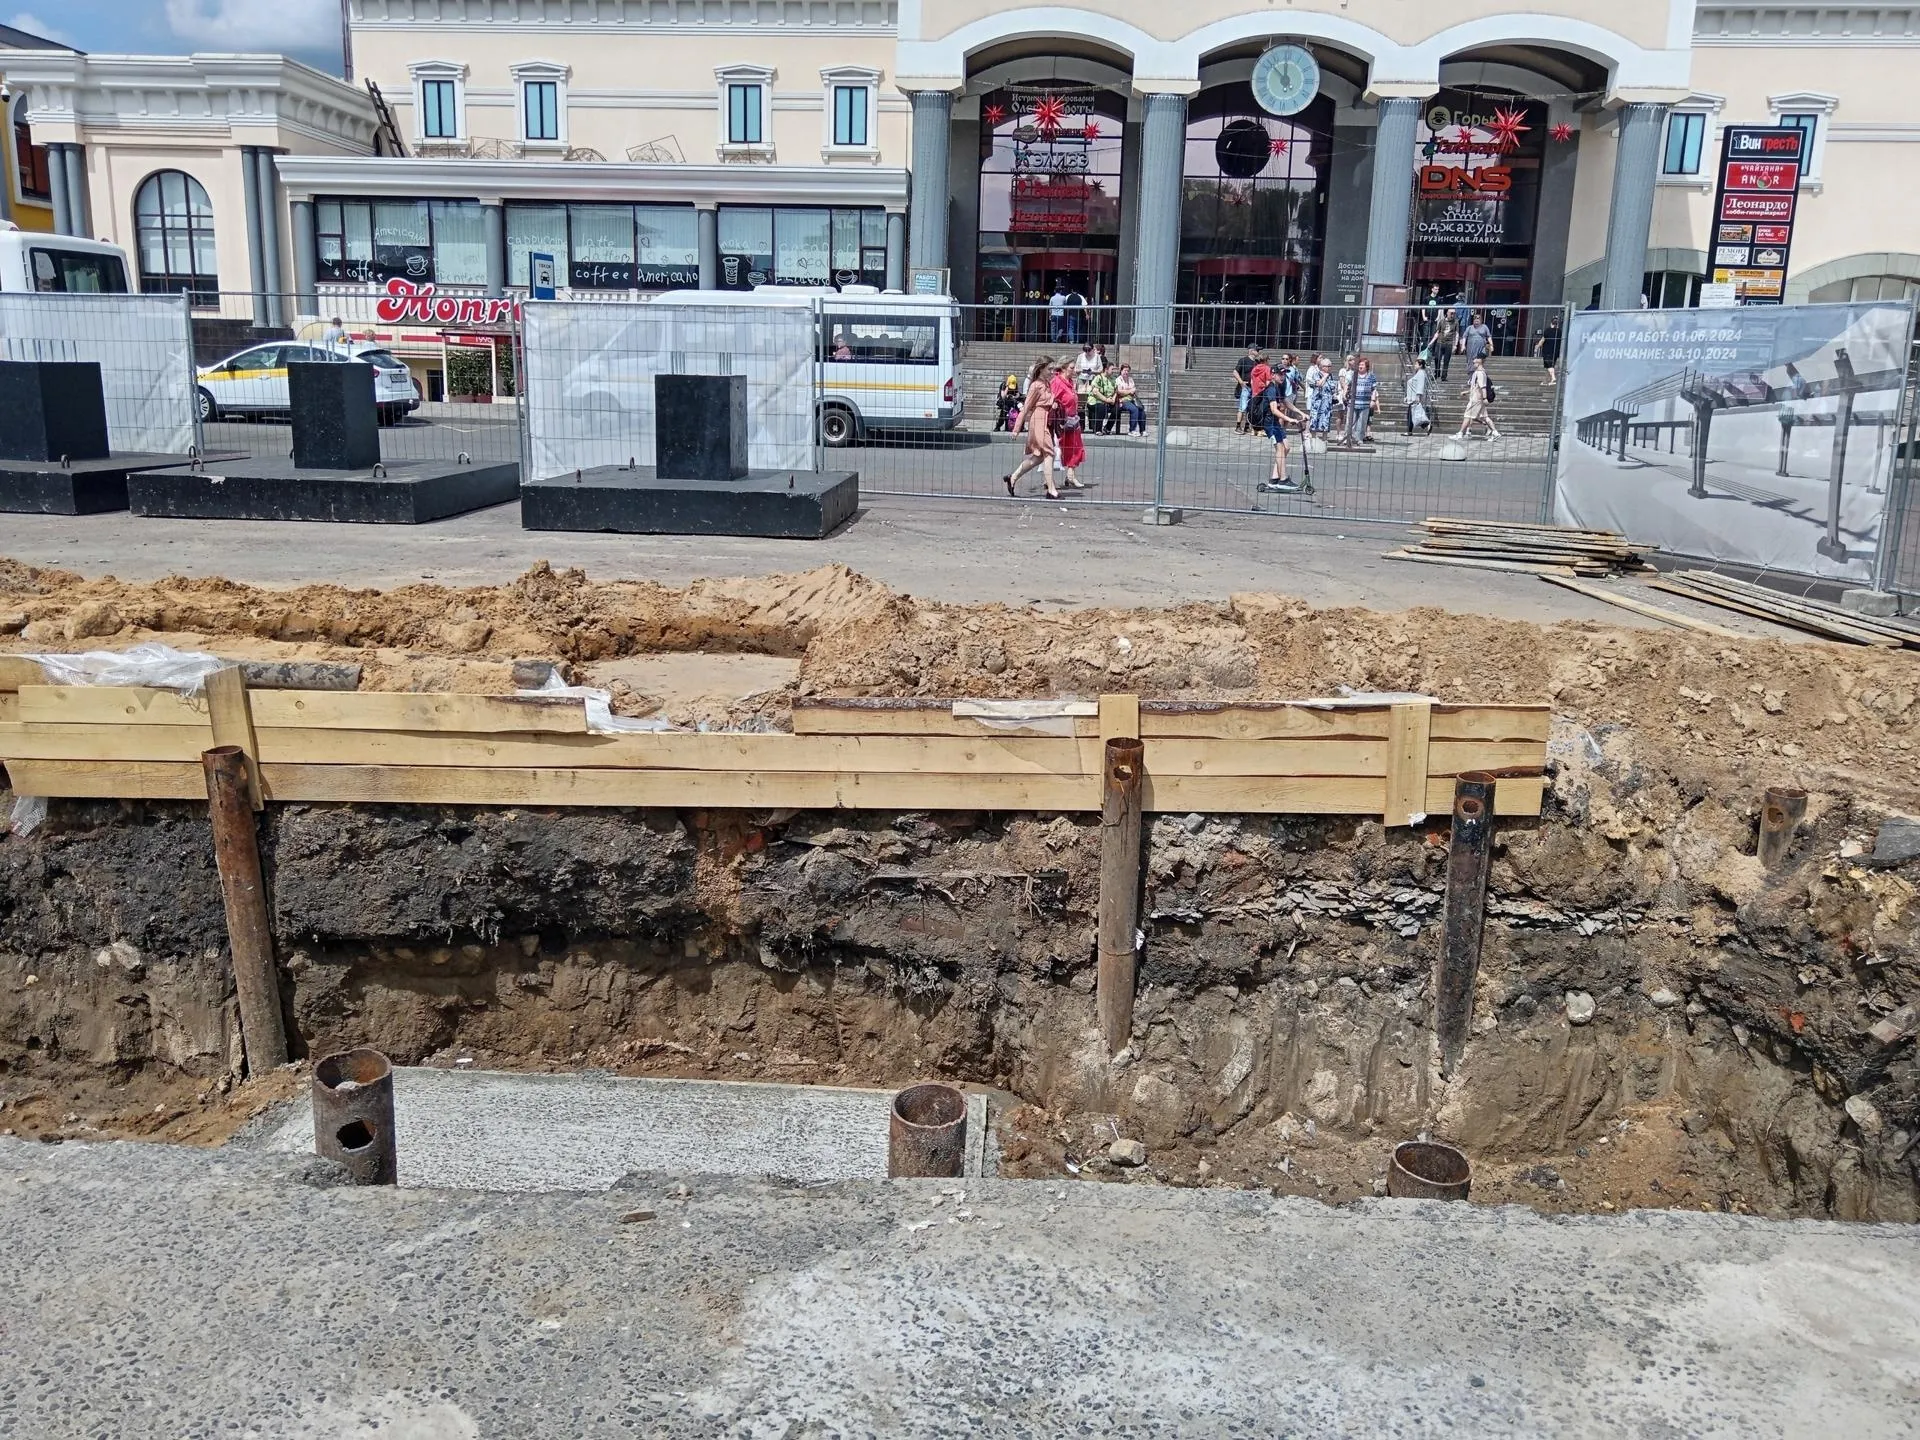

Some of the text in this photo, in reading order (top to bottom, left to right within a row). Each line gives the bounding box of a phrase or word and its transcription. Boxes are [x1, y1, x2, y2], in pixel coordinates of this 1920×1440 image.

[1420, 165, 1512, 191] DNS
[1726, 198, 1788, 211] Леонардо
[1419, 234, 1501, 243] ГРУЗИНСКАЯ ЛАВКА
[1338, 262, 1366, 270] Доставк
[575, 265, 629, 287] coffee
[637, 268, 700, 286] Americano
[1581, 329, 1743, 343] НАЧАЛО РАБОТ: 01.06.2024
[1594, 347, 1737, 360] ОКОНЧАНИЕ: 30.10.2024
